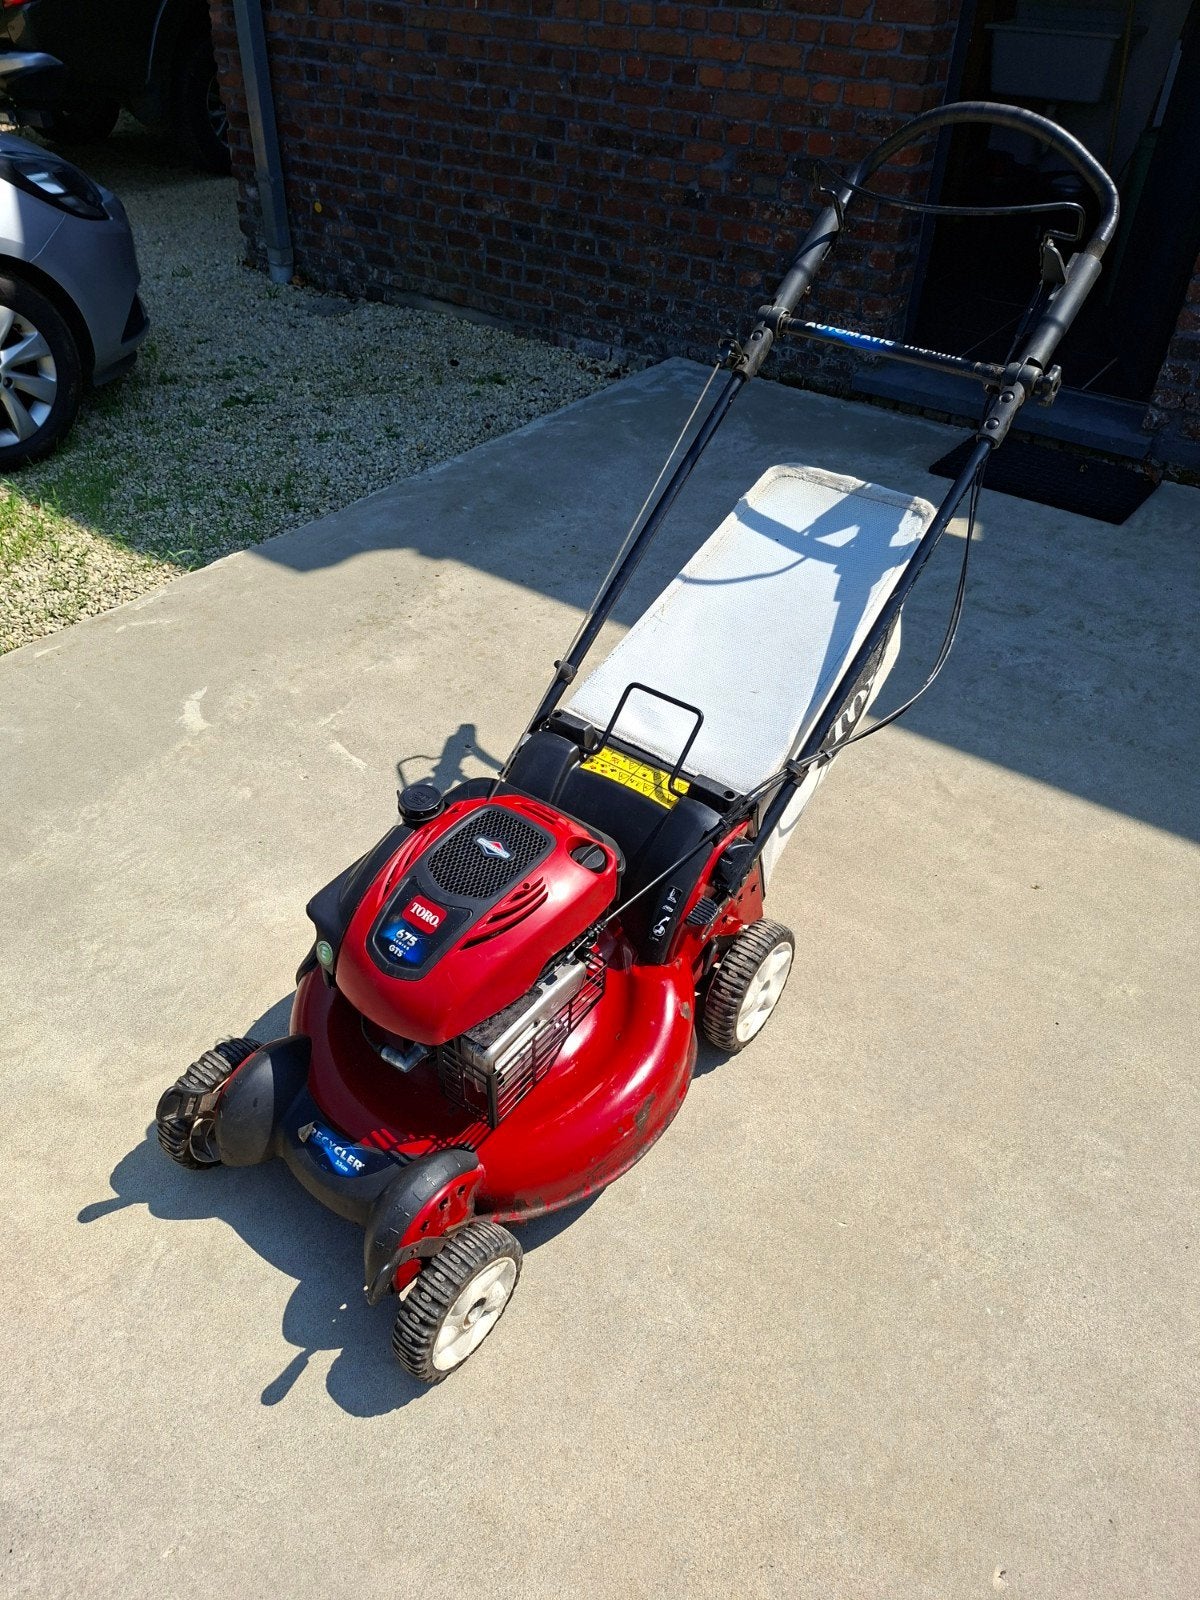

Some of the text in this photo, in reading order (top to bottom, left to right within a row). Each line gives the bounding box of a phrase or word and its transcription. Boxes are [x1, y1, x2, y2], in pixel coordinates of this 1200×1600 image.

[805, 321, 895, 346] AUTOMATIC
[410, 902, 440, 926] TORO
[396, 929, 418, 946] 675
[388, 944, 404, 957] GTS
